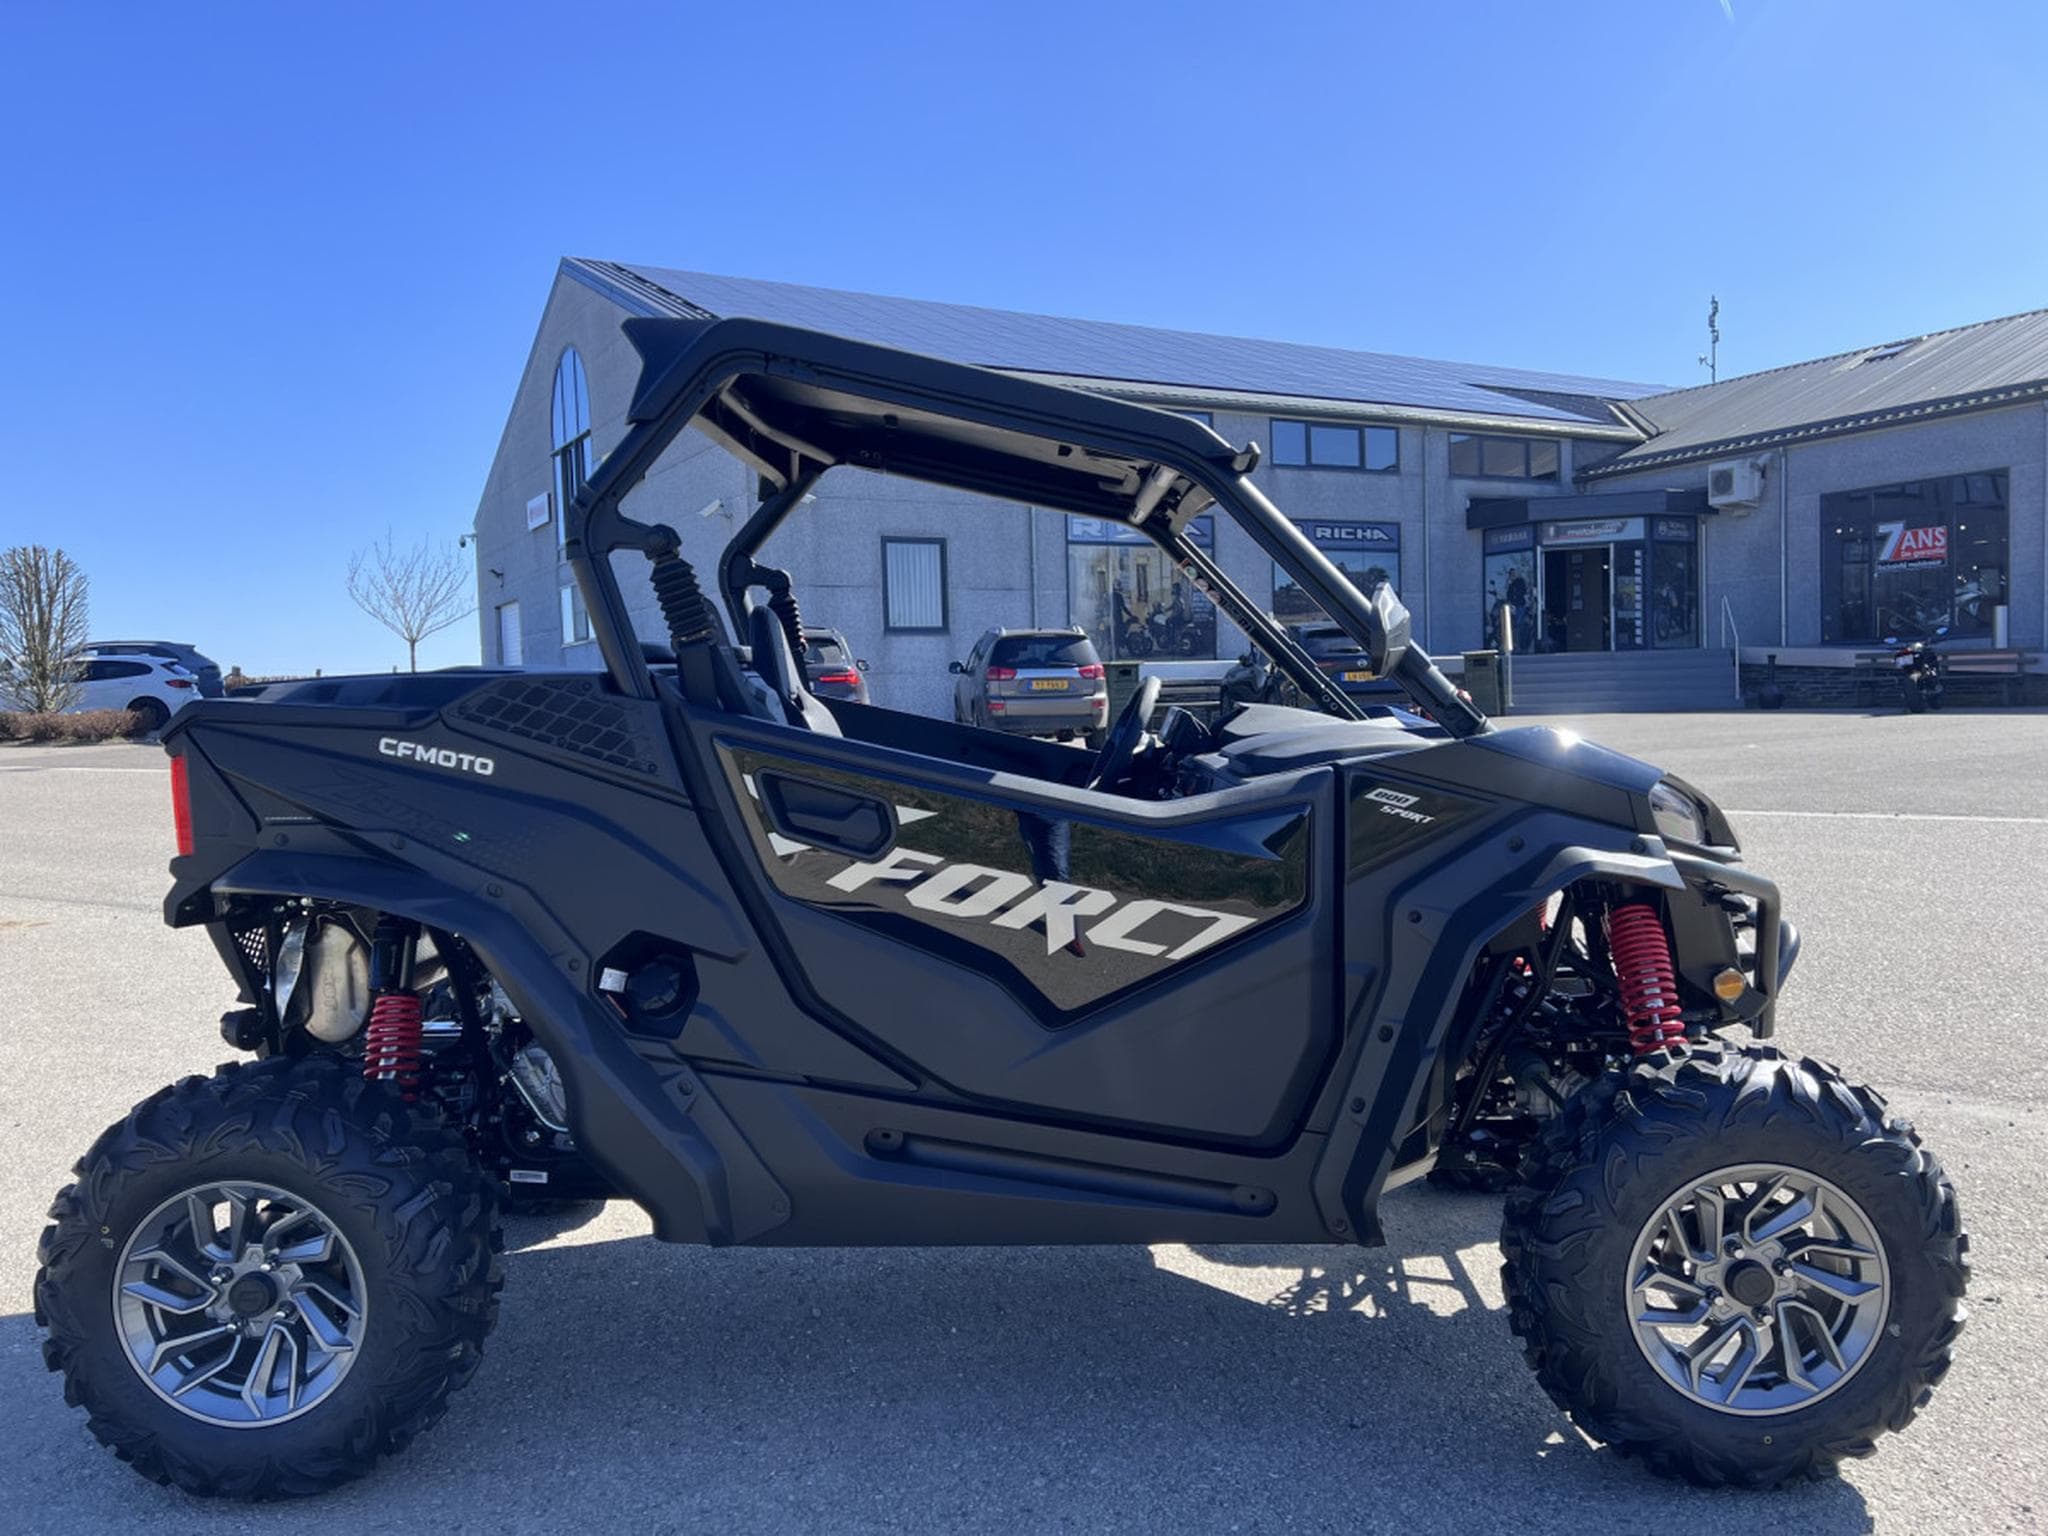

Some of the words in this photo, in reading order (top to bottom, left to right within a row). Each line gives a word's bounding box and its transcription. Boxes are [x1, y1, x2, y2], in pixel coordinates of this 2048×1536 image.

[1315, 526, 1391, 541] RICHA
[1878, 521, 1905, 561] 7
[1900, 526, 1947, 550] ANS
[378, 736, 495, 776] CFMOTO
[1380, 805, 1435, 823] SPORT
